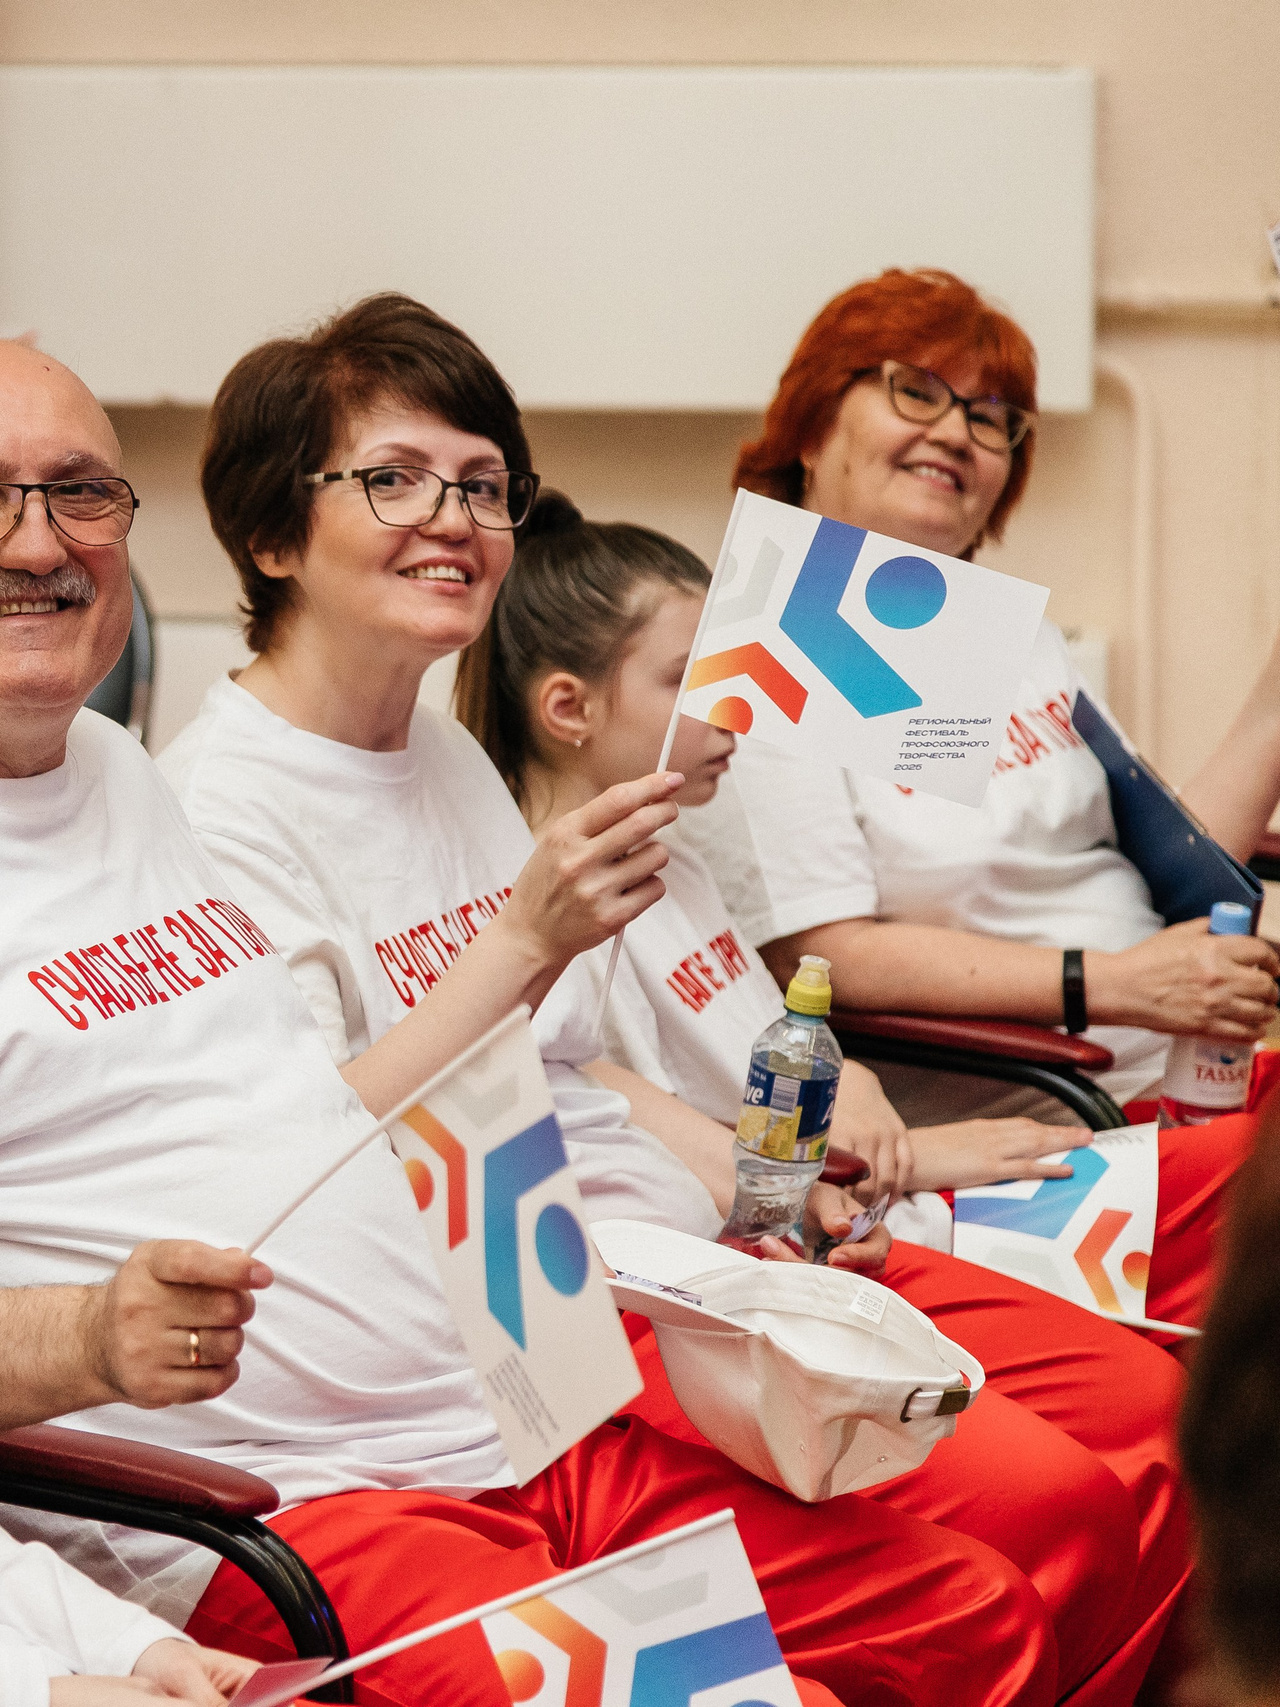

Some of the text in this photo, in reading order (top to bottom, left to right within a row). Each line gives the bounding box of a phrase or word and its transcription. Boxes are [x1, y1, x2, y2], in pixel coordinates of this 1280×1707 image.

[908, 717, 992, 725] РЕГИОНАЛЬНЫЙ
[901, 740, 990, 748] ПРОФСОЮЗНОГО
[894, 763, 922, 771] 2025
[130, 924, 205, 996] НЕ
[163, 909, 238, 978] ЗА
[27, 934, 170, 1030] СЧАСТЬЕ
